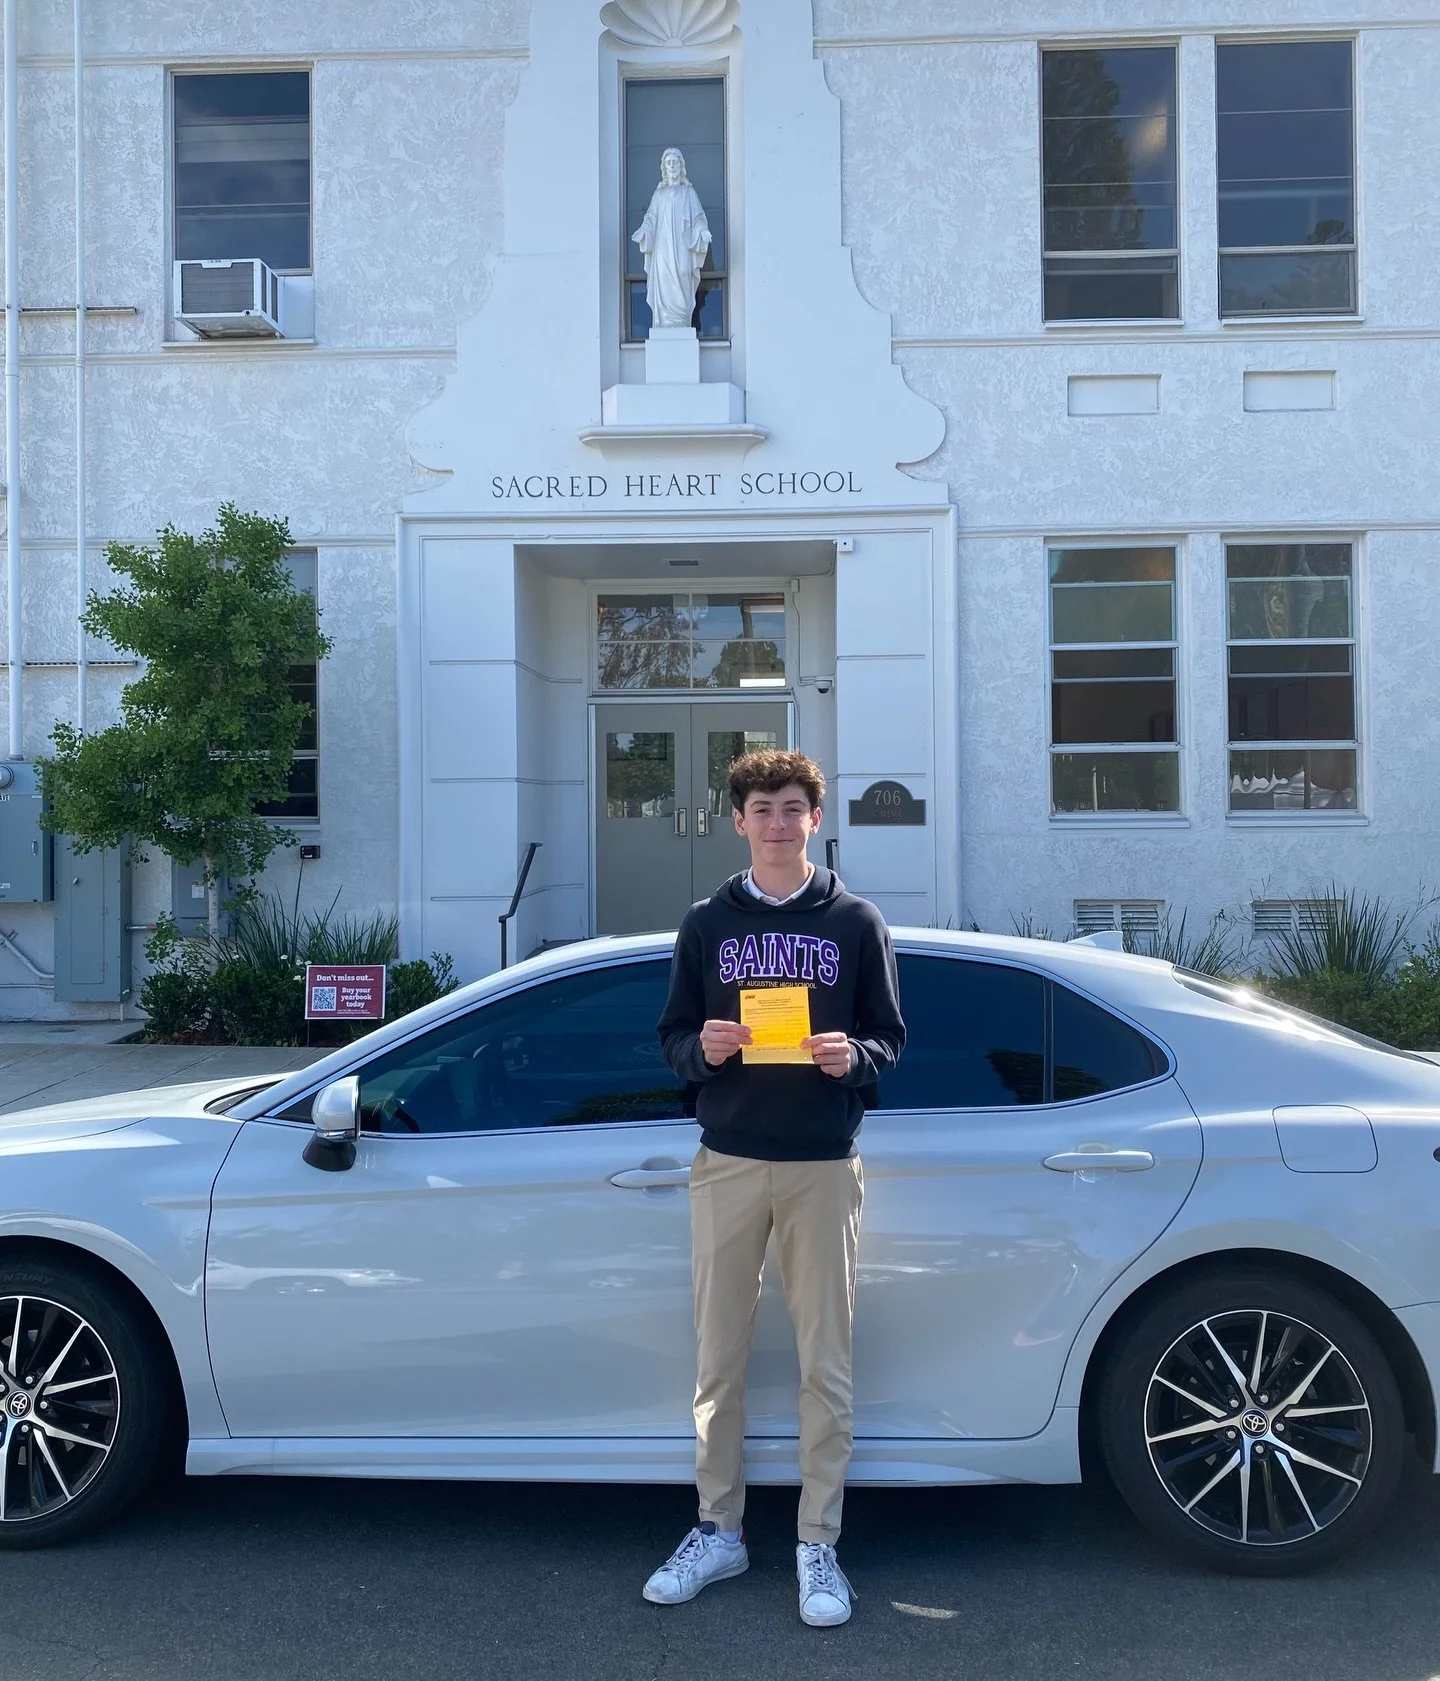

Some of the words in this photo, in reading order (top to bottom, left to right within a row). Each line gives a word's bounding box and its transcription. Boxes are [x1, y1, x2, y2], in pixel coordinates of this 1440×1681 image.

[491, 475, 608, 498] SACRED
[624, 473, 722, 497] HEART
[740, 471, 863, 496] SCHOOL
[873, 790, 901, 805] 706
[719, 932, 840, 987] SAINTS
[316, 974, 337, 982] Don't
[337, 974, 355, 982] miss
[342, 987, 355, 995] Buy
[340, 993, 373, 1002] yearbook
[346, 1001, 366, 1009] today
